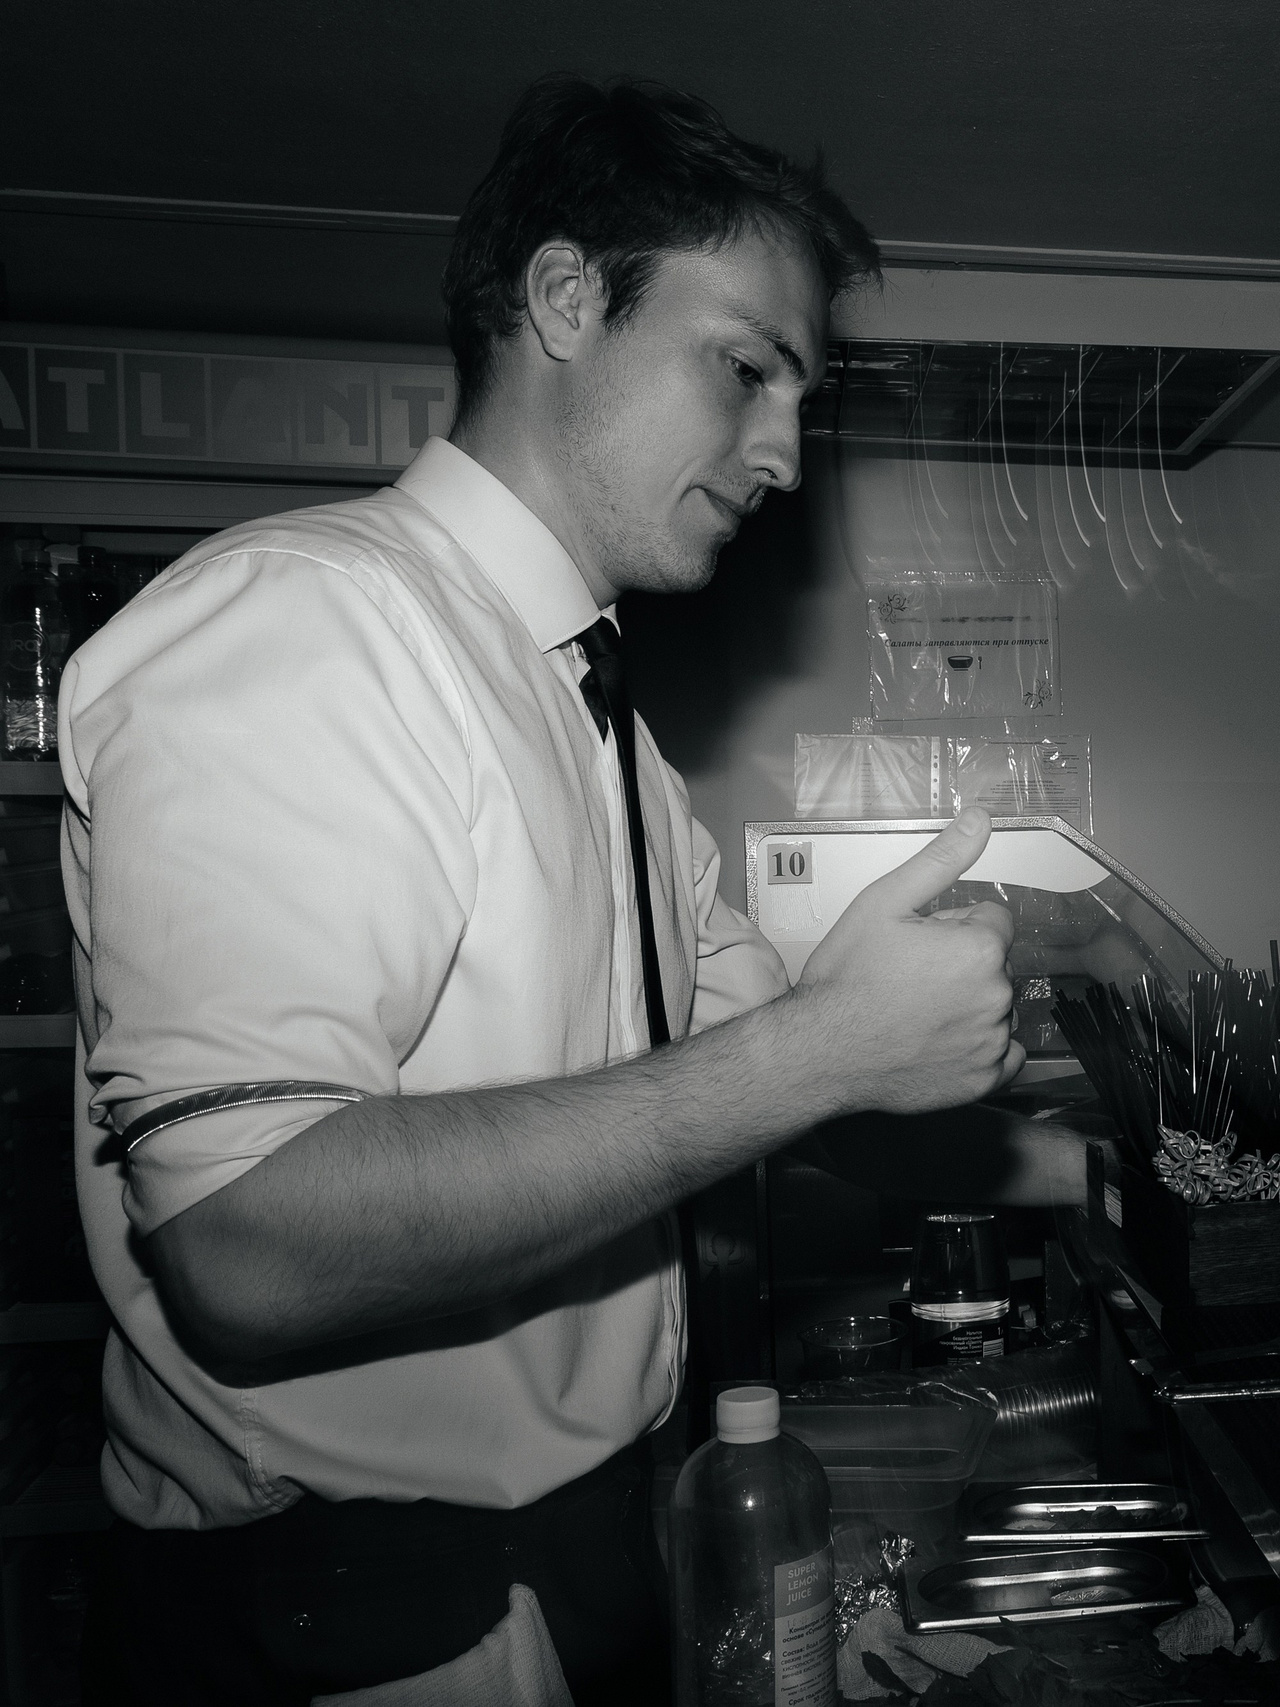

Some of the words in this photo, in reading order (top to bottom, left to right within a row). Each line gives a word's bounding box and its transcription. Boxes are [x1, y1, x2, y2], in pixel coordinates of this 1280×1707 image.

[884, 638, 922, 648] Салаты
[925, 639, 990, 649] заправляются
[992, 638, 1009, 648] при
[1011, 638, 1049, 648] отпуске
[772, 852, 805, 877] 10
[787, 1562, 816, 1579] SUPER
[788, 1572, 819, 1591] LEMON
[786, 1587, 812, 1606] JUICE
